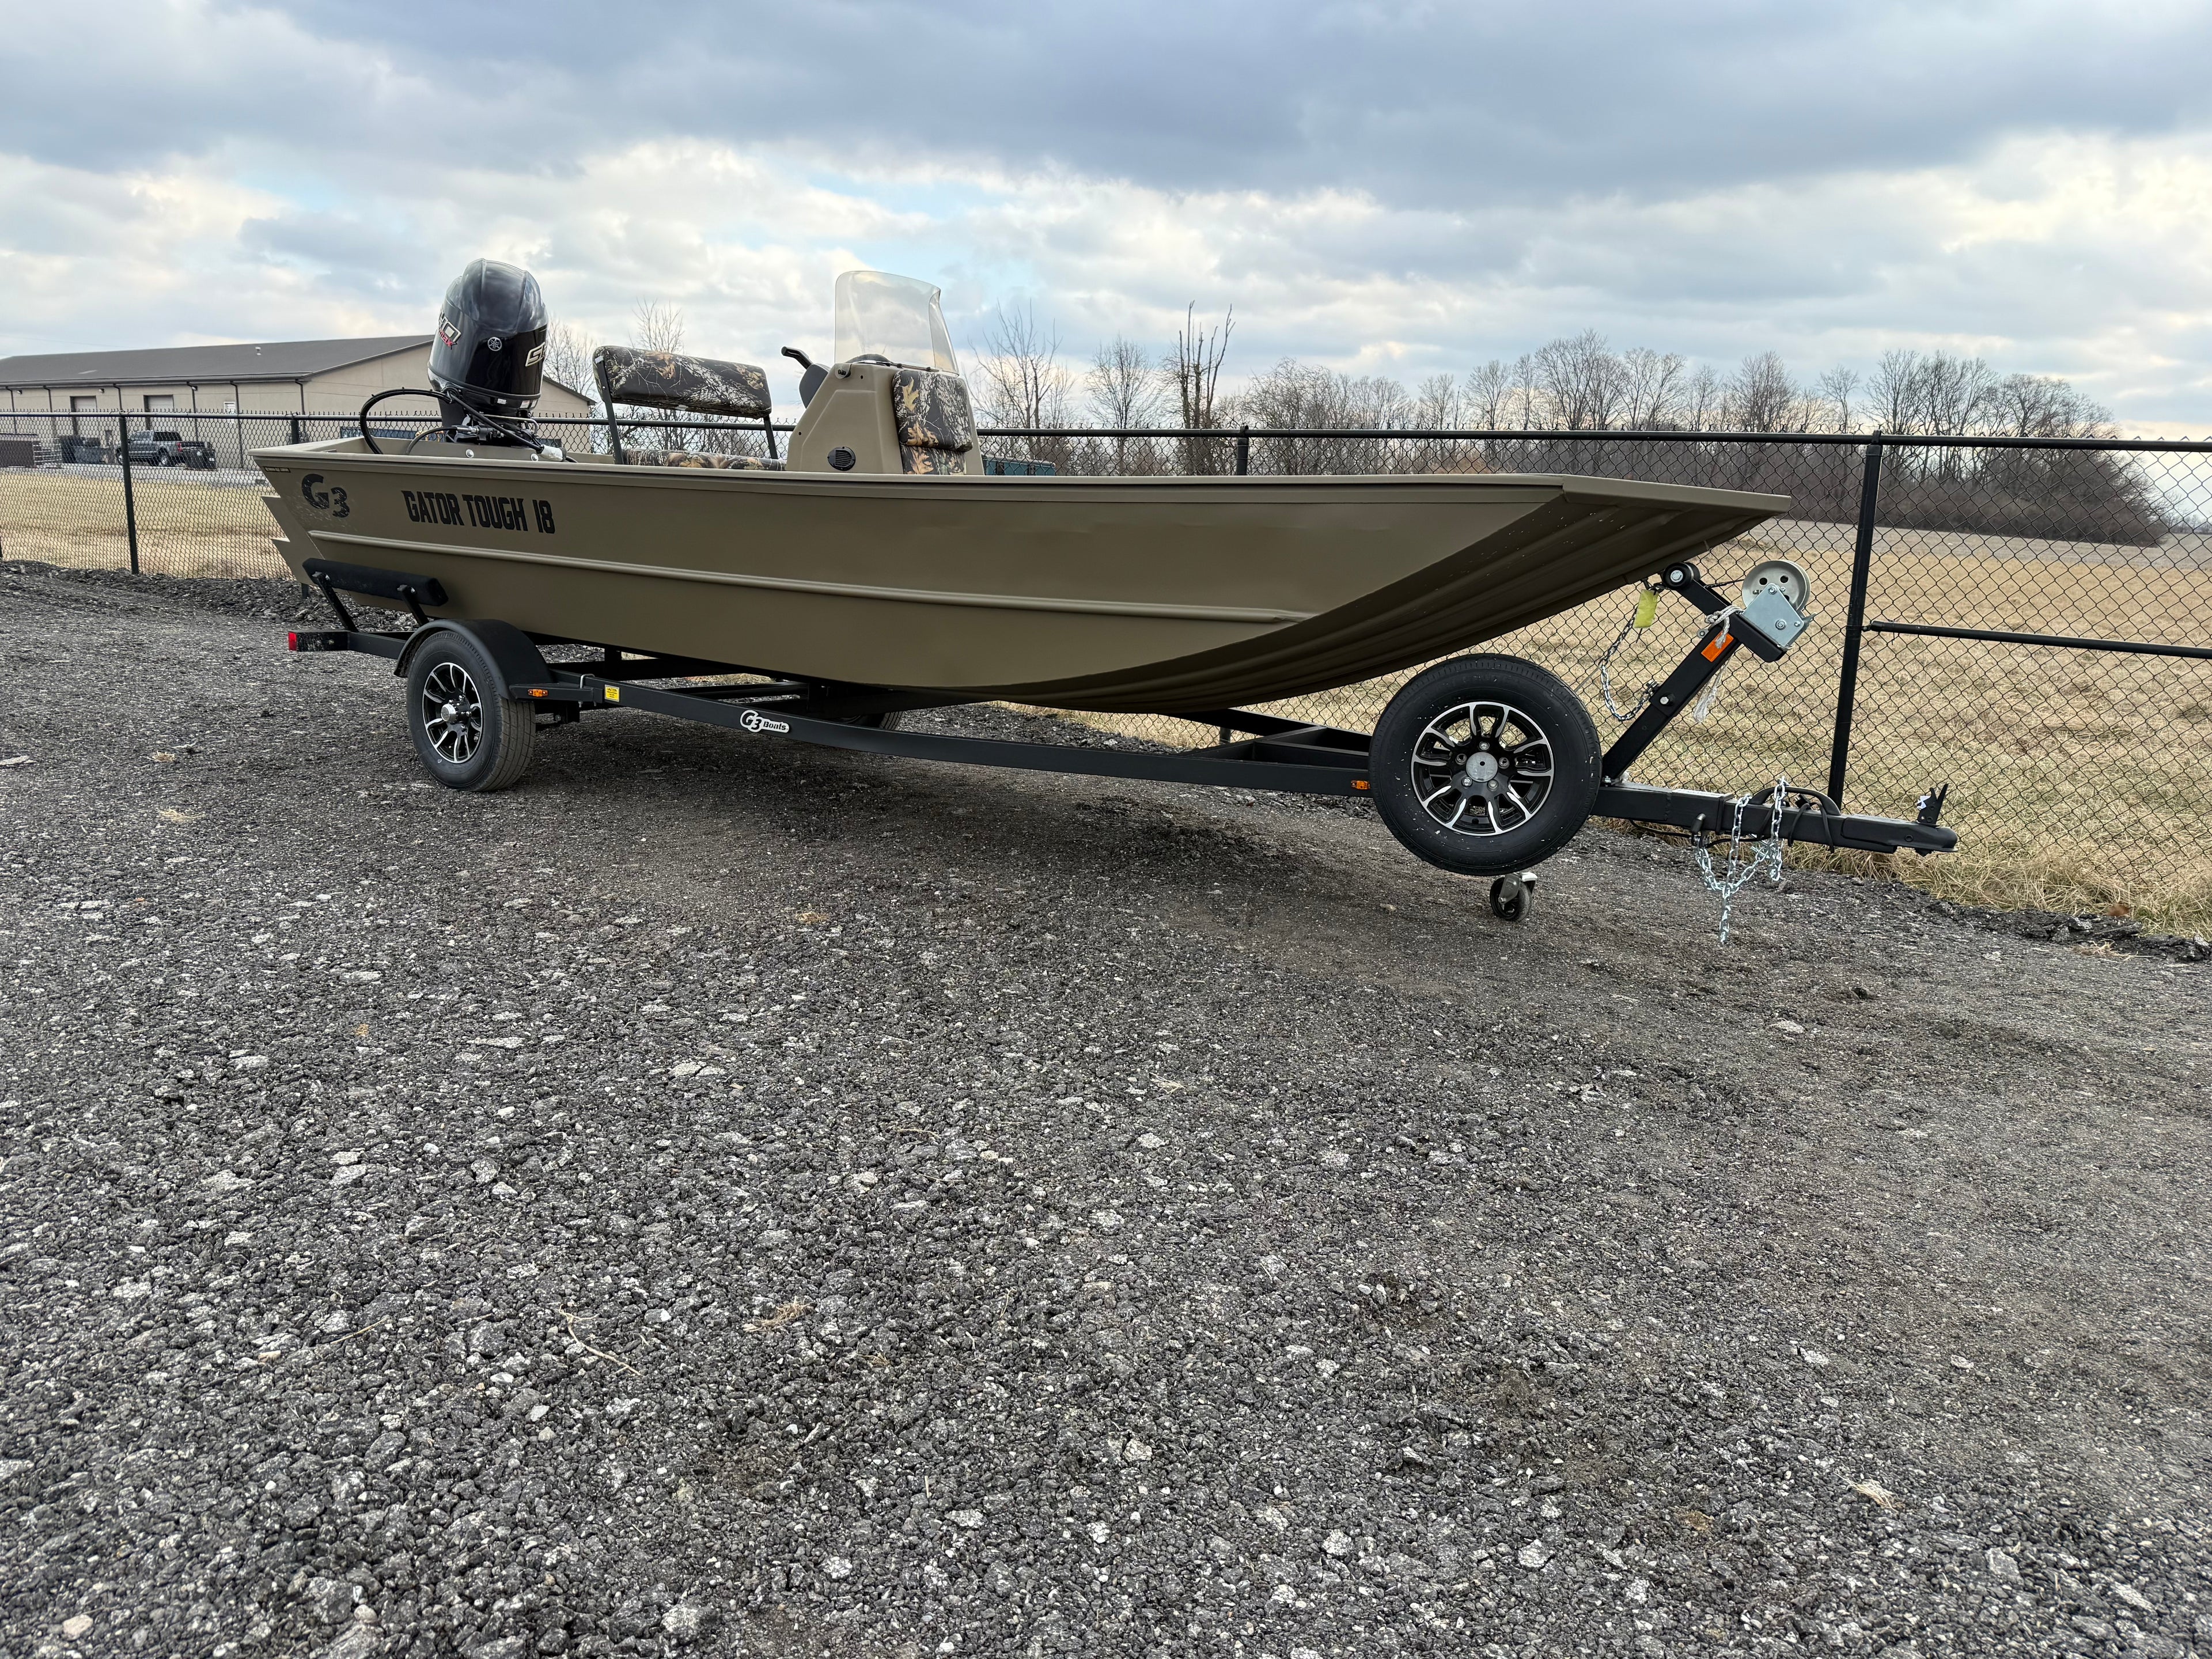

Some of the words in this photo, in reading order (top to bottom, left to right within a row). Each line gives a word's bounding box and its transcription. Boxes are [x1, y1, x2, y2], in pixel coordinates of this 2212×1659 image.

[301, 473, 350, 518] G3
[401, 490, 464, 525] GATOR
[461, 494, 528, 531] TOUGH
[532, 499, 556, 534] 18
[741, 711, 763, 730] G3
[763, 721, 787, 730] Boats
